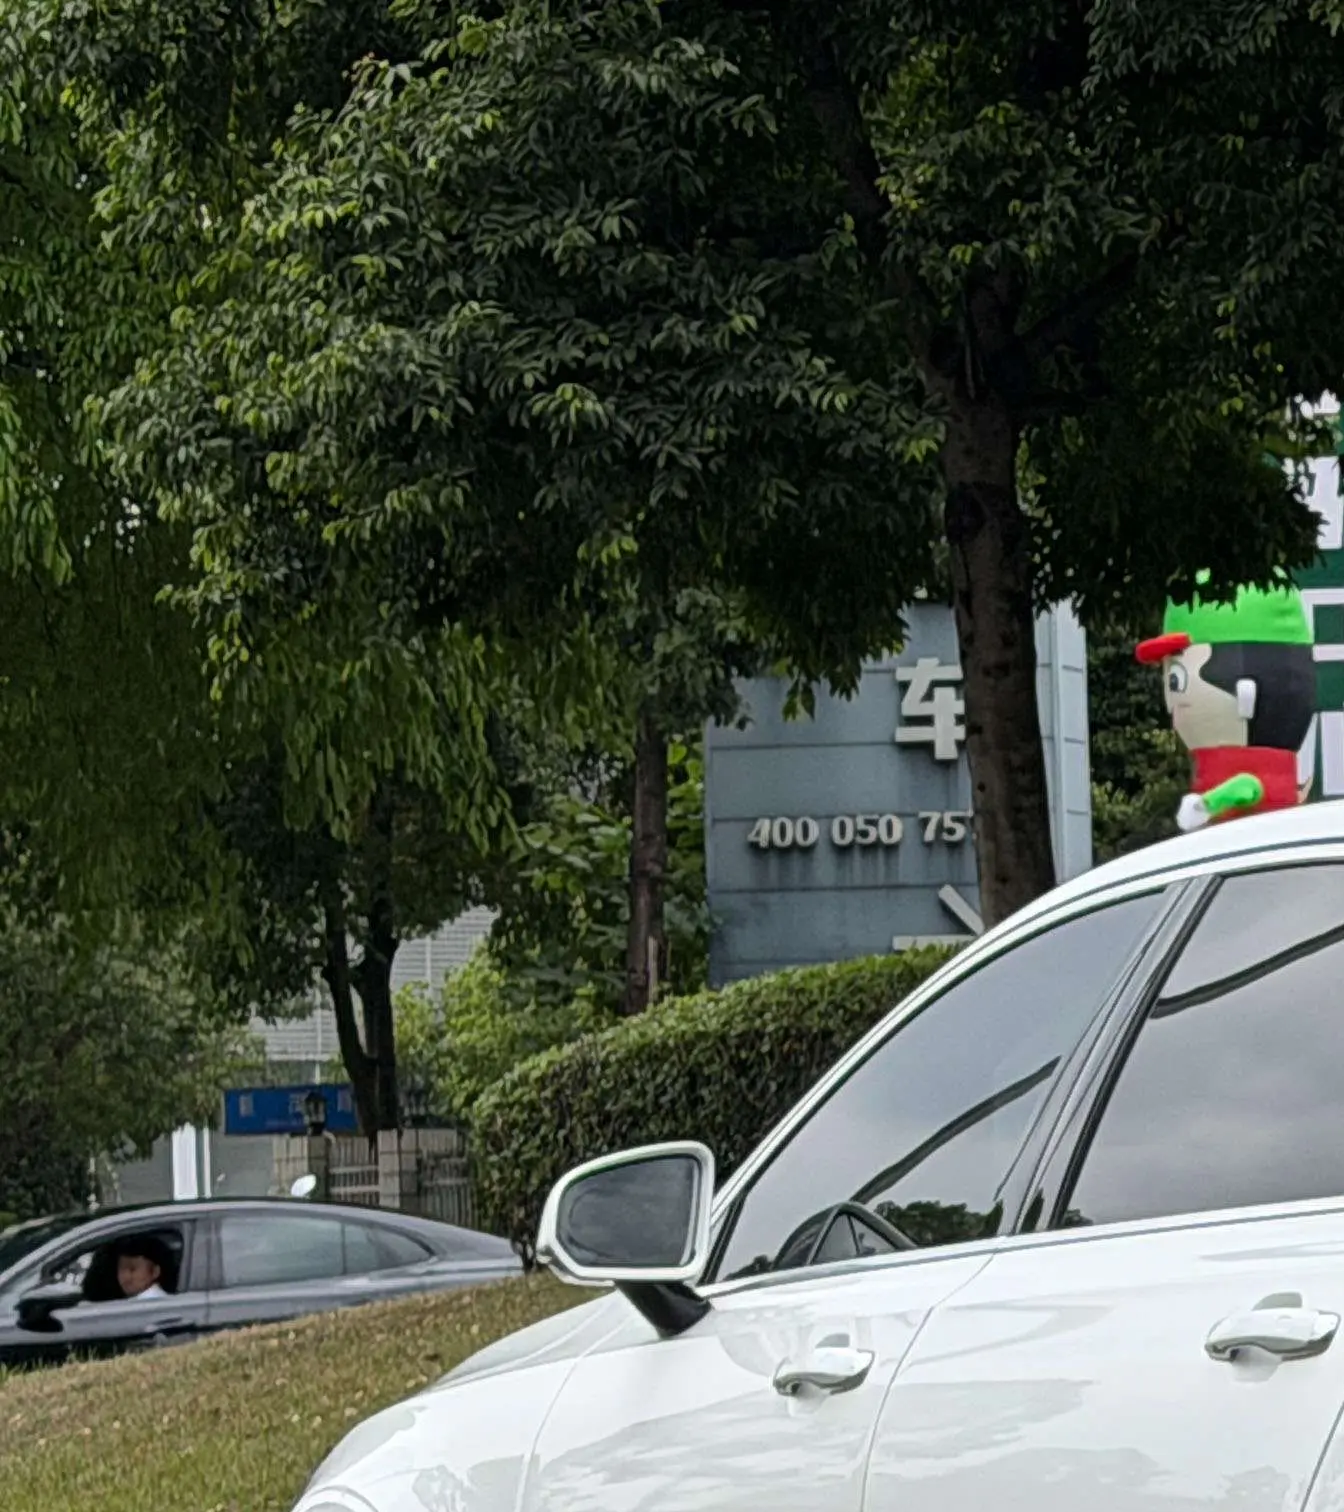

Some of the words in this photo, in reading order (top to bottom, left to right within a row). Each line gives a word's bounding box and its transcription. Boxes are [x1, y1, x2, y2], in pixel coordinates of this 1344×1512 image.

[895, 657, 967, 760] 车
[747, 815, 820, 849] 400
[831, 813, 903, 847] 050
[918, 808, 975, 844] 75
